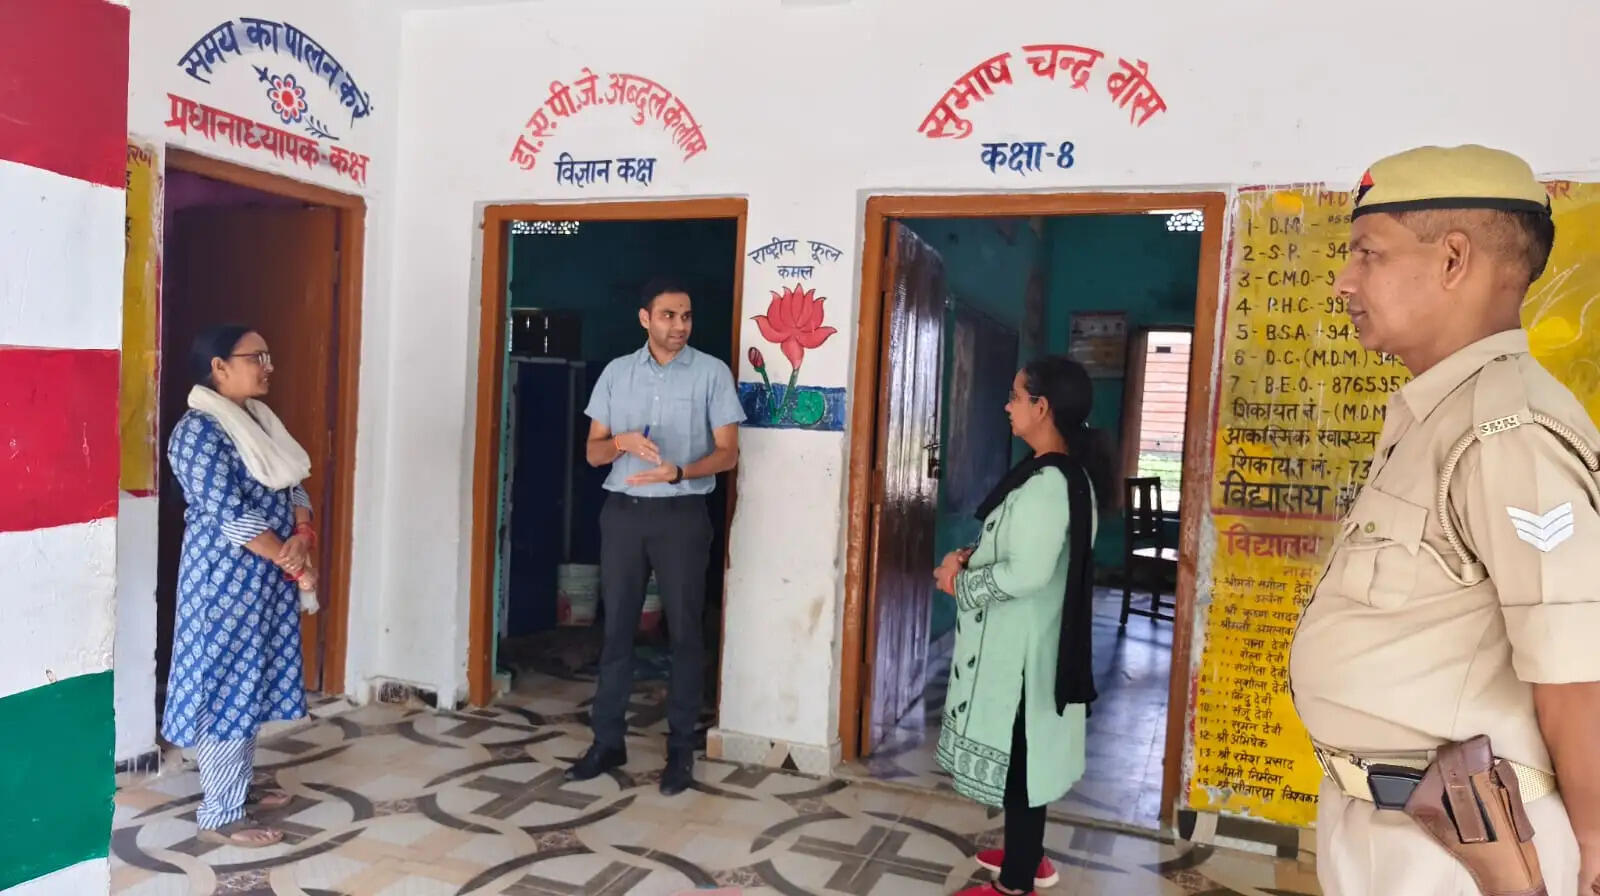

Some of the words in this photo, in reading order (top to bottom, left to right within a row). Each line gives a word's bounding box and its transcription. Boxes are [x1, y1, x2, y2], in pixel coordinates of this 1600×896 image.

[177, 20, 241, 84] समय
[239, 17, 282, 54] का
[283, 22, 344, 91] पालन
[340, 71, 374, 129] करें
[917, 52, 1013, 139] सुभाष
[1021, 44, 1105, 93] चन्द्र
[554, 152, 612, 187] विज्ञान
[616, 157, 657, 186] कक्ष
[748, 236, 799, 265] राष्ट्रीय
[807, 240, 845, 264] फूल
[776, 265, 815, 280] कमल
[1232, 397, 1301, 423] शिकायत
[1219, 469, 1331, 514] विद्यालय
[1220, 523, 1324, 559] विद्यालय
